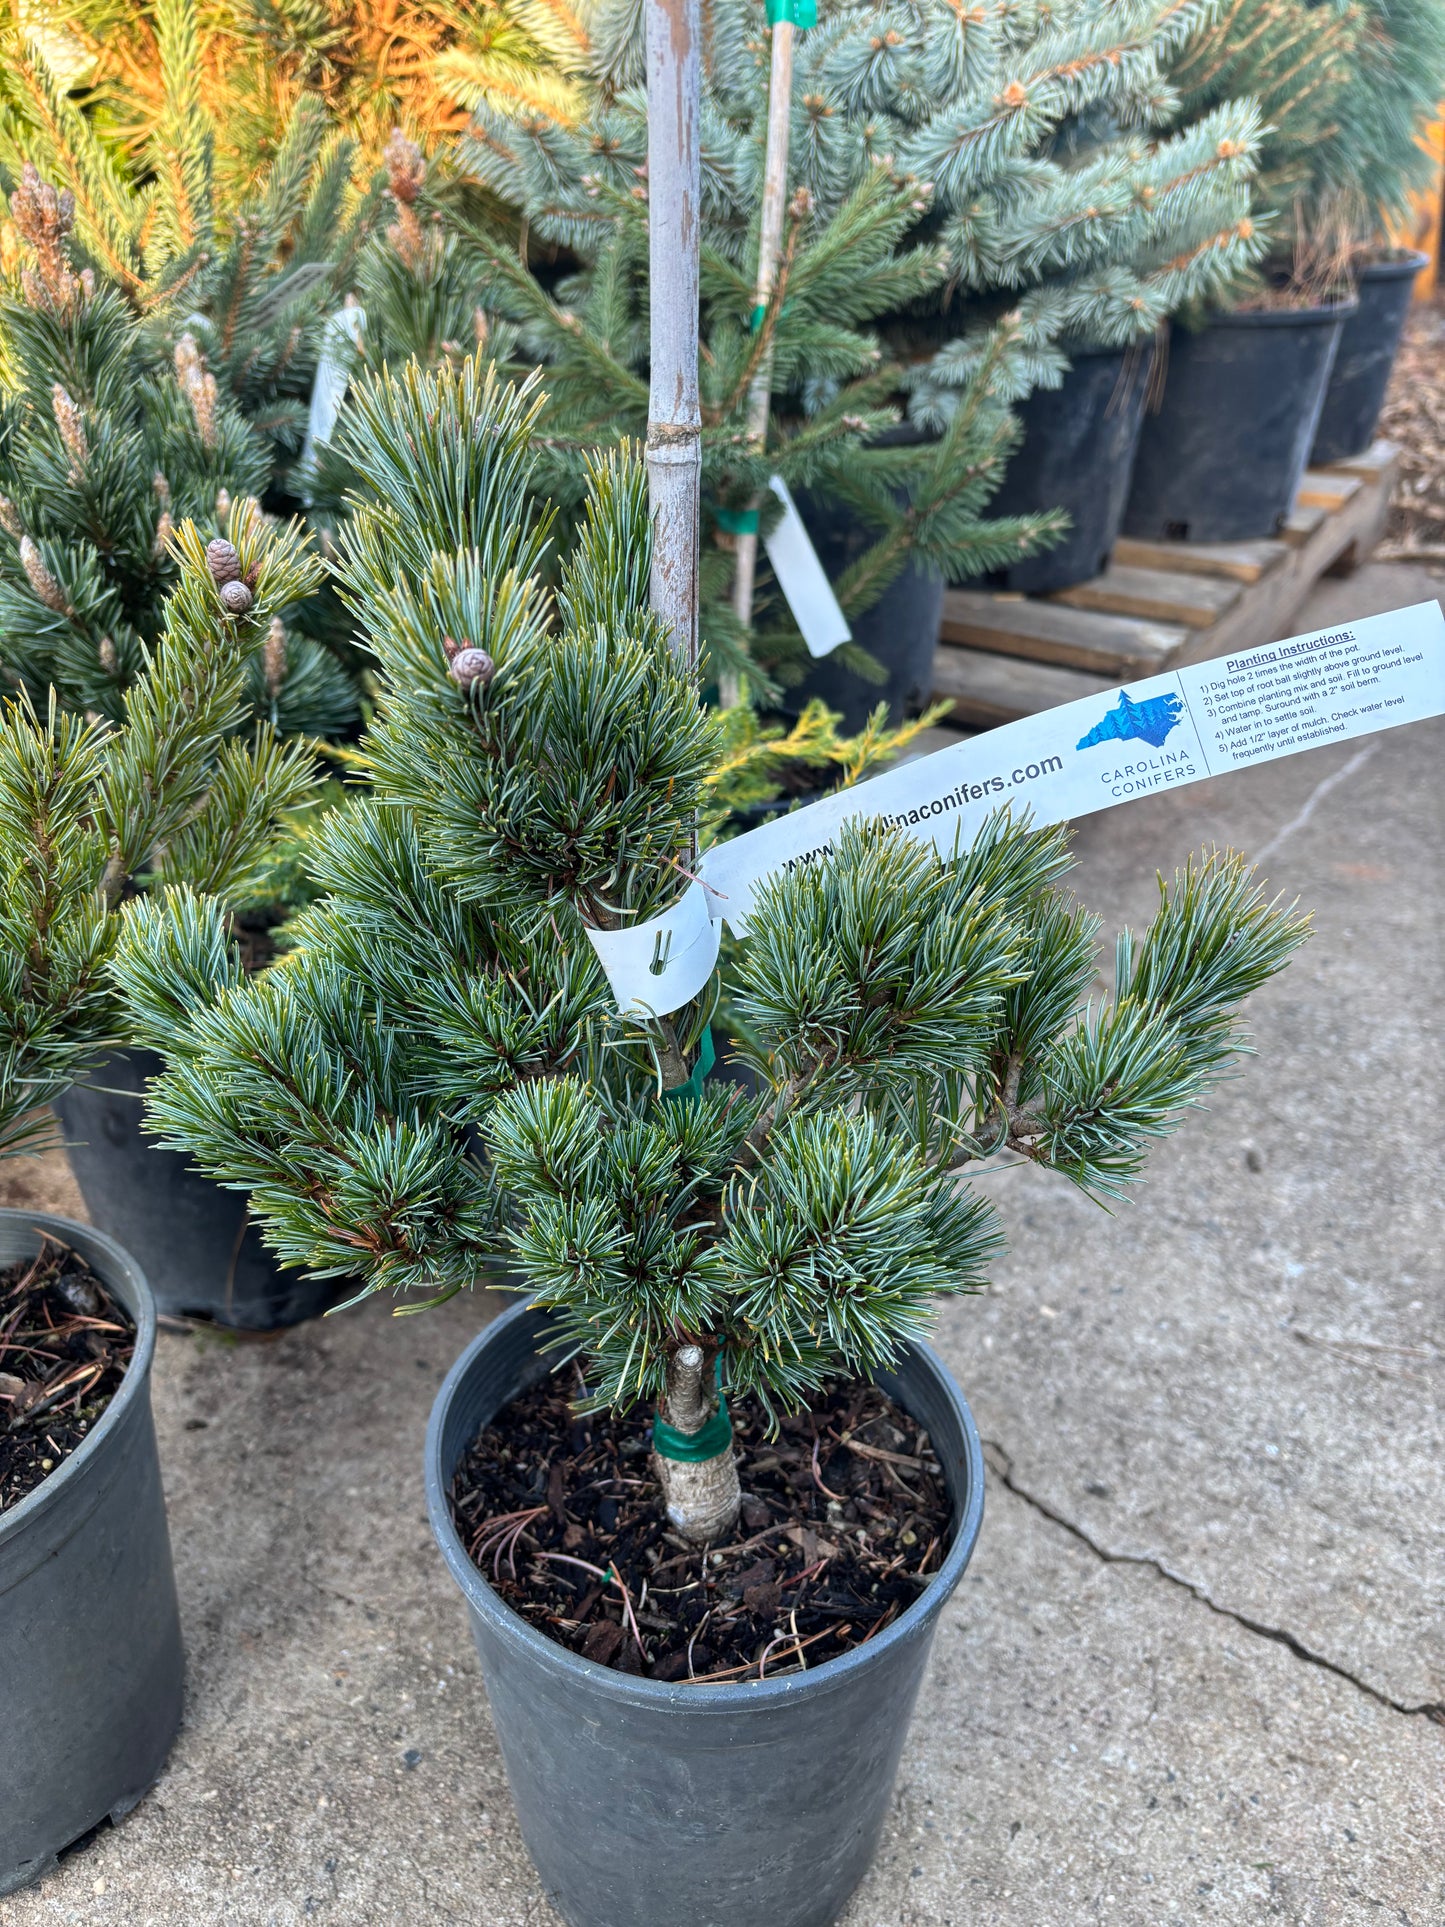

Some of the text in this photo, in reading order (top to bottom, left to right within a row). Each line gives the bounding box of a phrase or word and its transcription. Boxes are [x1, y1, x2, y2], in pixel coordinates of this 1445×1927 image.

[1200, 644, 1360, 694] 1) Dig hole 2 times the width of the pot.
[1226, 631, 1354, 672] Planting Instructions:
[1203, 645, 1405, 706] 2) Set top of root ball slightly above ground level.
[1207, 708, 1217, 718] 3)
[1218, 699, 1257, 715] Combine
[1258, 689, 1293, 705] planting
[1293, 684, 1309, 693] mix
[1310, 678, 1327, 689] and
[1328, 673, 1346, 684] soil.
[1346, 668, 1361, 679] Fill
[1372, 658, 1402, 674] ground
[1402, 652, 1424, 664] level
[1215, 731, 1224, 740] 4)
[1225, 724, 1252, 737] Water
[1253, 721, 1263, 729] in
[1274, 711, 1298, 723] settle
[1299, 705, 1317, 716] soil.
[1221, 714, 1238, 725] and
[1239, 709, 1263, 720] tamp.
[1302, 692, 1321, 703] with
[1340, 681, 1356, 692] soil
[1356, 677, 1381, 688] berm.
[1219, 743, 1229, 753] 5)
[1230, 738, 1248, 750] Add
[1267, 727, 1289, 739] layer
[1291, 723, 1300, 732] of
[1301, 717, 1330, 730] mulch.
[1331, 708, 1359, 722] Check
[1359, 702, 1383, 714] water
[1384, 696, 1405, 707] level
[1232, 722, 1348, 760] frequently until established.
[1101, 750, 1190, 783] CAROLINA
[1111, 764, 1196, 797] CONIFERS
